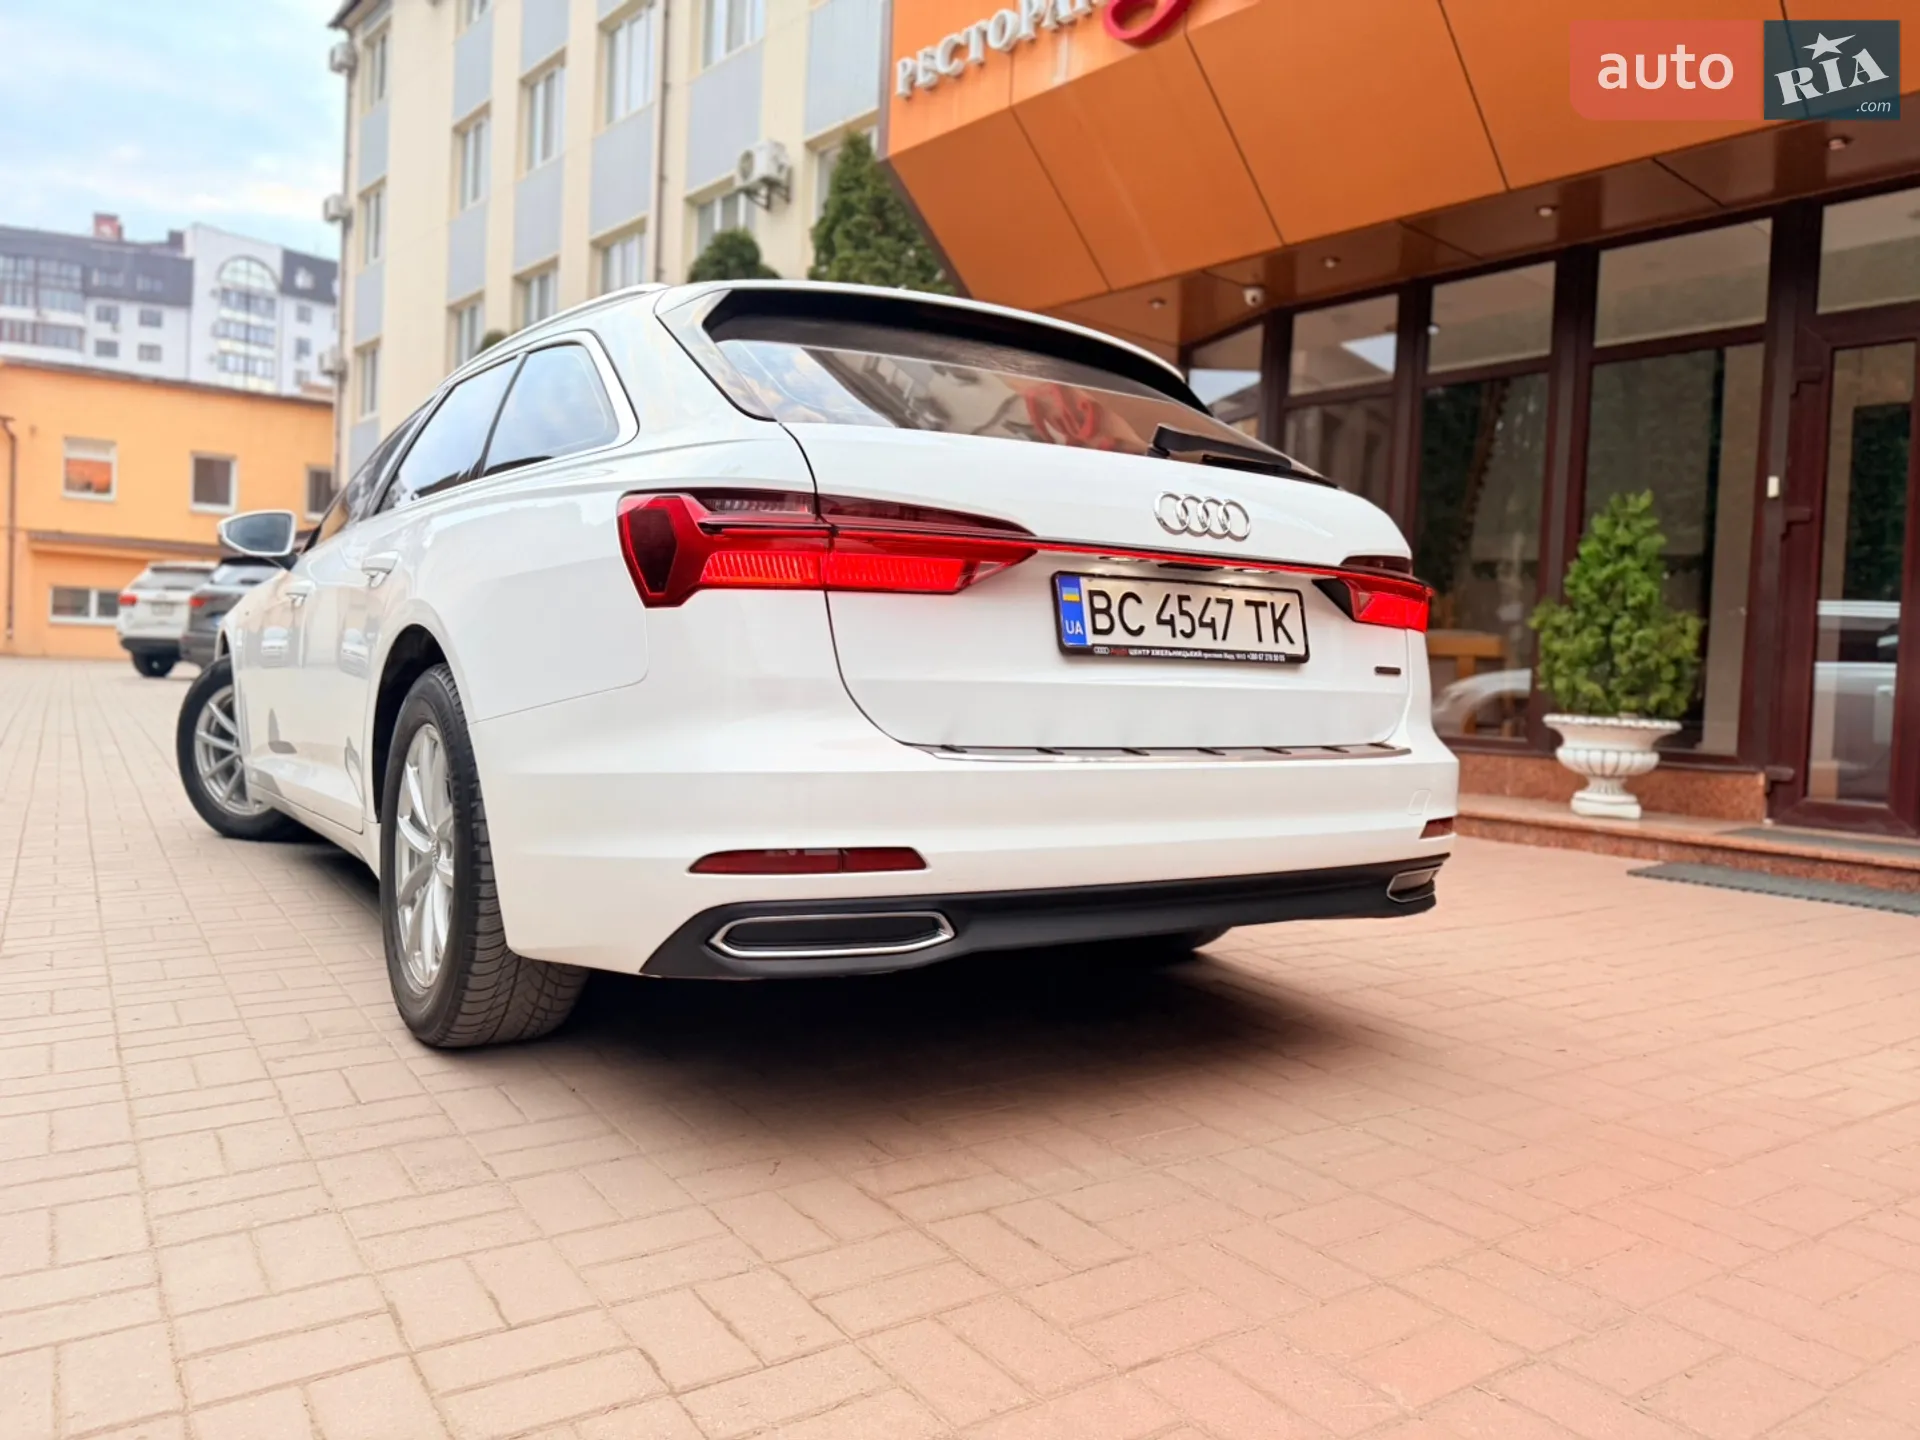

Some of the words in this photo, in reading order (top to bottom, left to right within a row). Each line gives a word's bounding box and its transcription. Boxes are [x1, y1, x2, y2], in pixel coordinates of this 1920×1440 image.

[896, 0, 1098, 98] РЕСТОРА
[1064, 620, 1084, 636] UA
[1087, 589, 1146, 637] BC
[1155, 593, 1234, 641] 4547
[1244, 599, 1296, 645] TK
